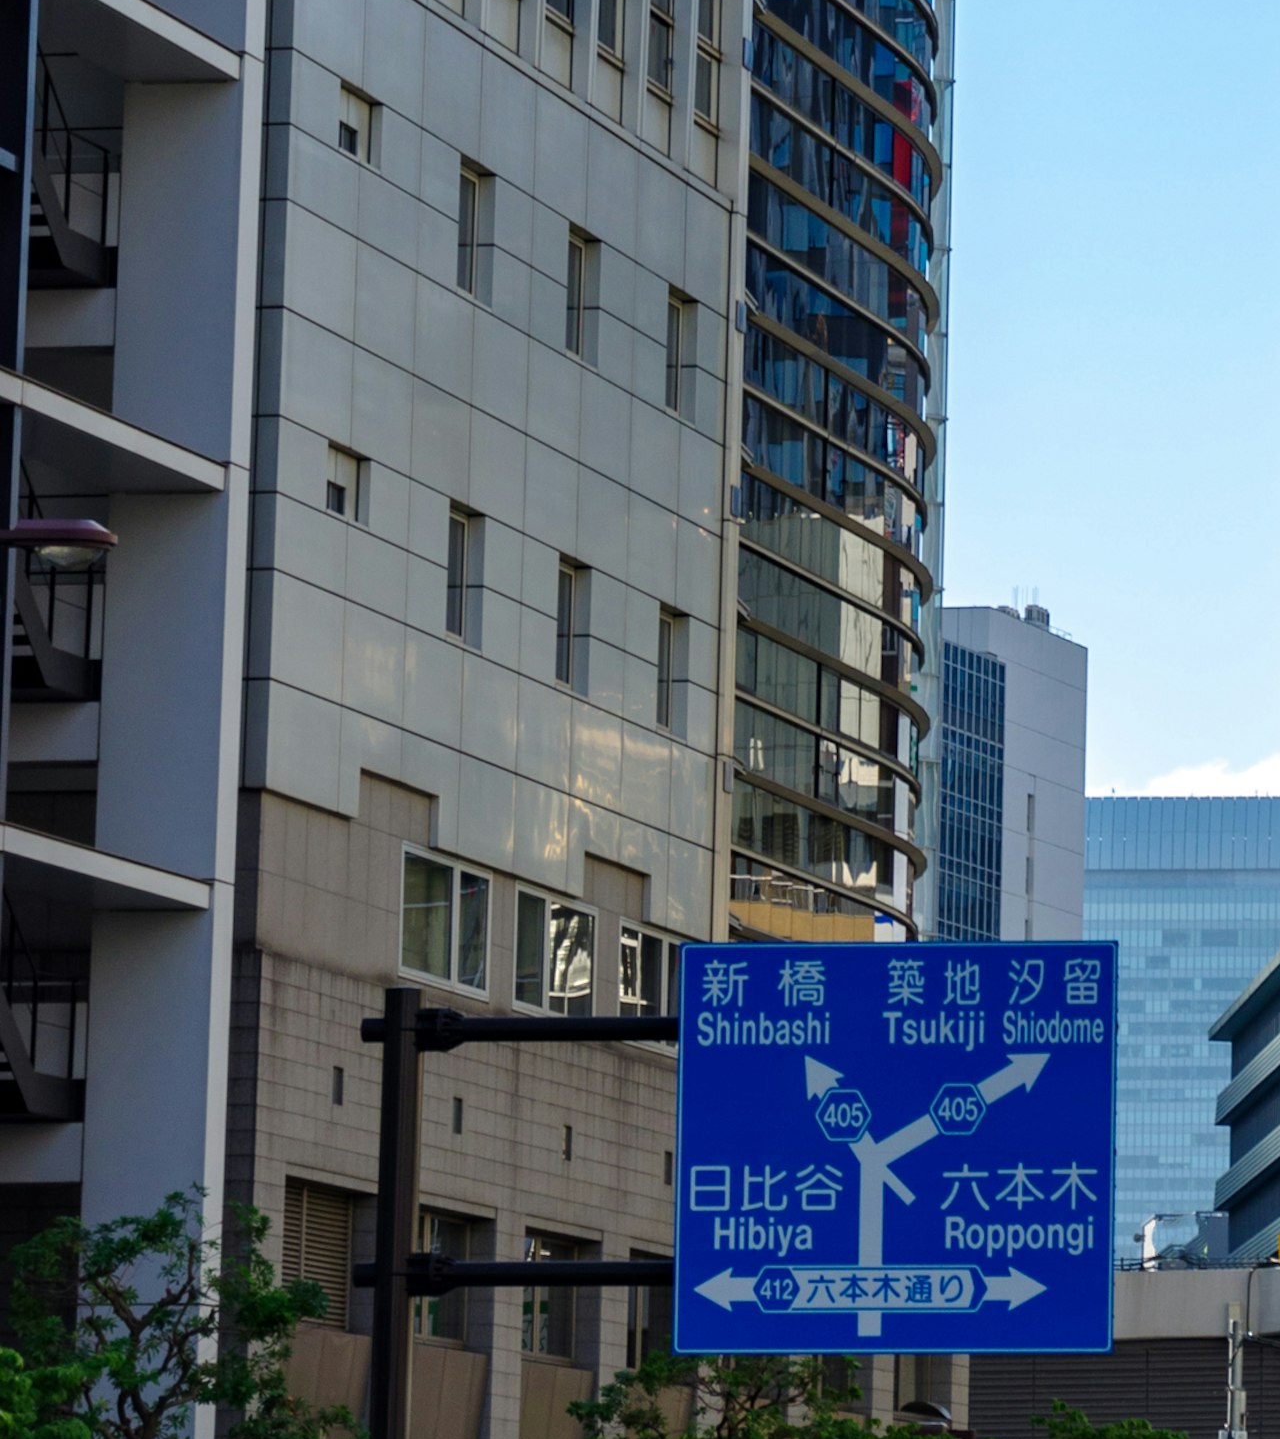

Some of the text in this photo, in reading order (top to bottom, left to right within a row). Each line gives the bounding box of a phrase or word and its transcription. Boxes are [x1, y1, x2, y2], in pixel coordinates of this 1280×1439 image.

[701, 959, 827, 1008] 新橋
[886, 958, 1101, 1007] 築地 汐留
[697, 1011, 831, 1047] Shinbashi
[882, 1010, 1105, 1051] Tsukiji Shiodome
[823, 1102, 864, 1128] 405
[937, 1097, 978, 1122] 405
[689, 1164, 843, 1212] 日比谷
[940, 1161, 1098, 1211] 六本木
[713, 1217, 813, 1257] Hibiya
[944, 1216, 1095, 1258] Roppongi
[758, 1277, 794, 1301] 412
[806, 1273, 966, 1306] 六本木通り
